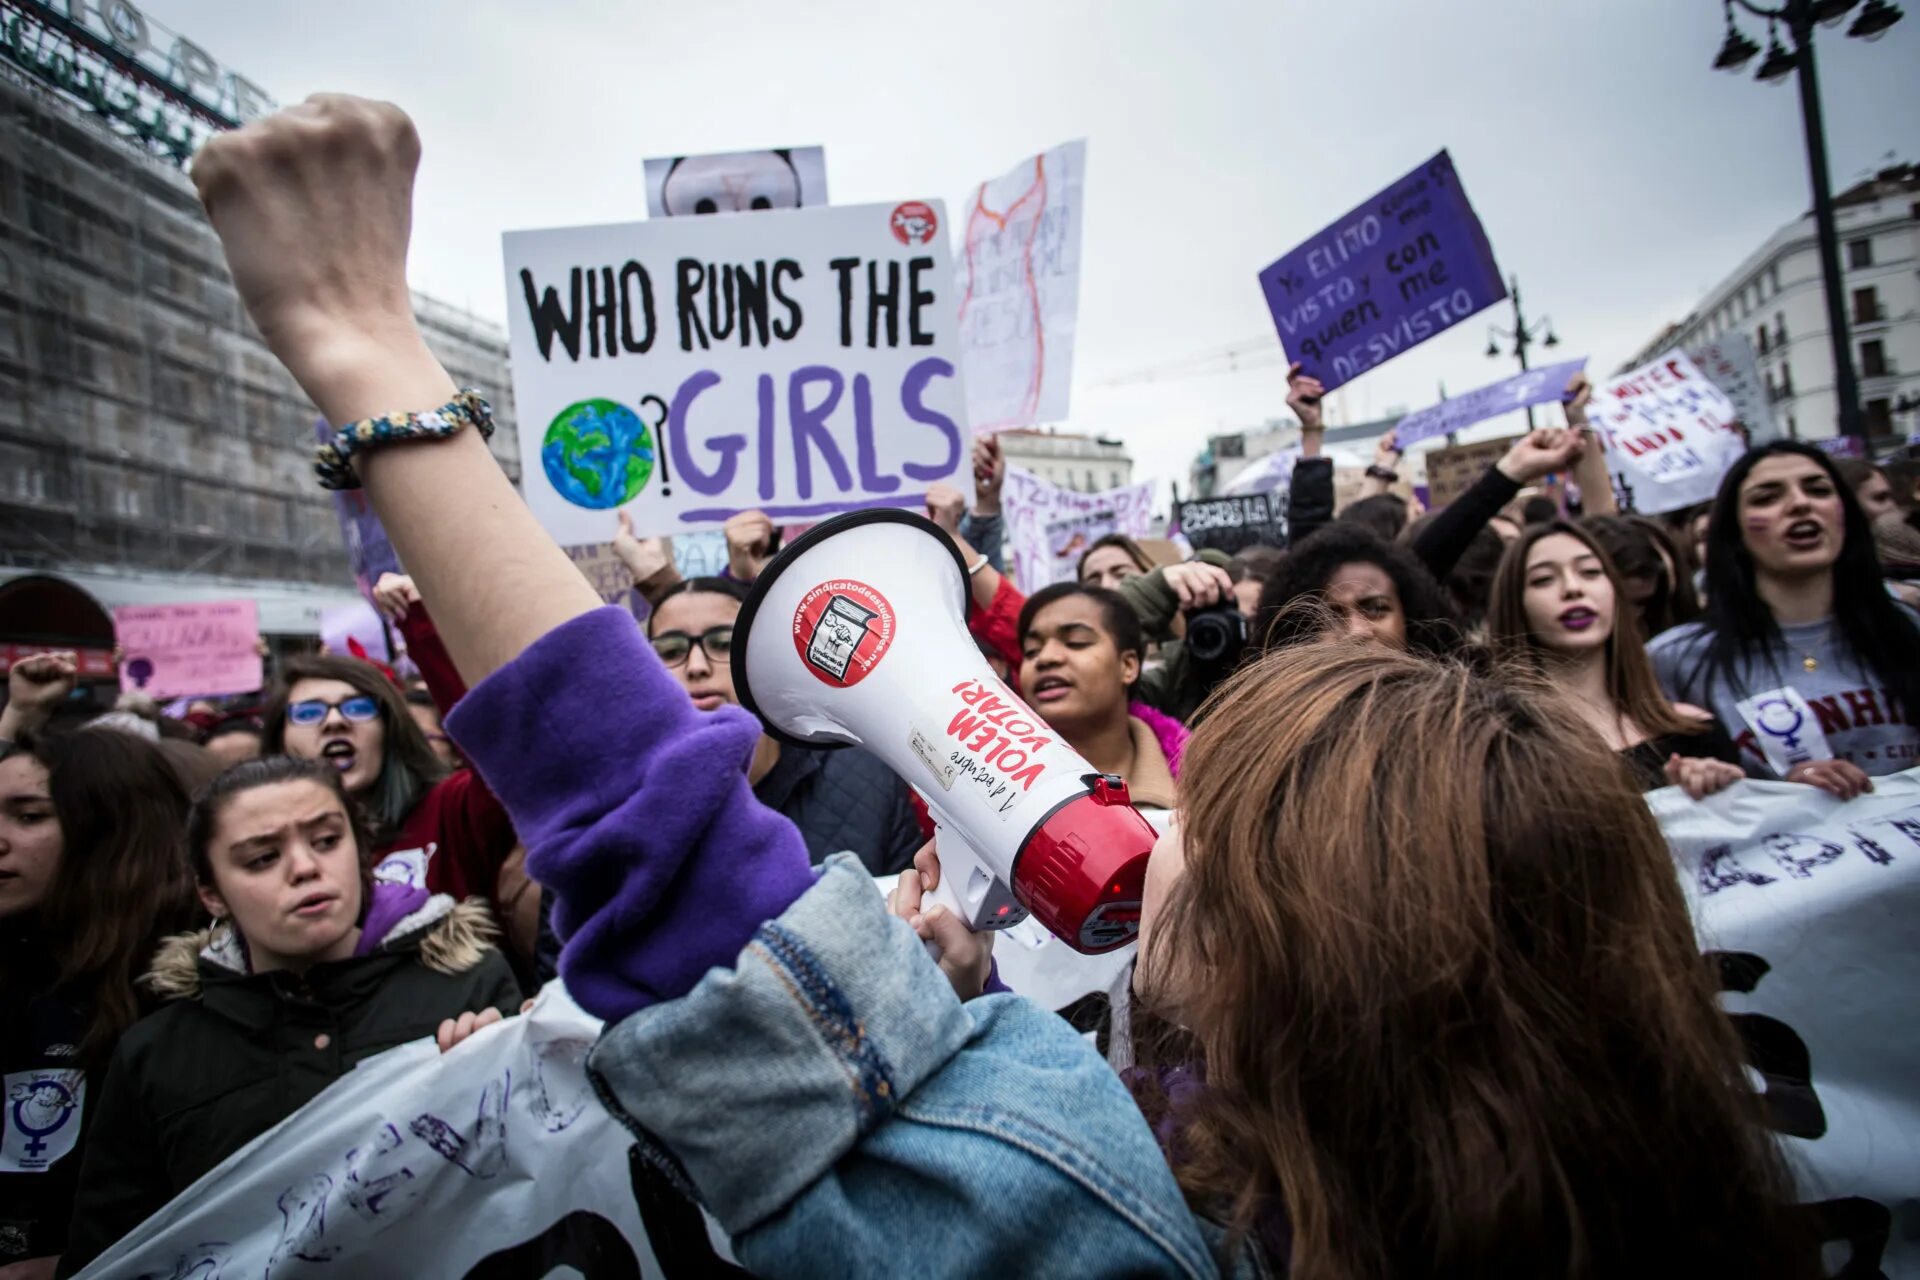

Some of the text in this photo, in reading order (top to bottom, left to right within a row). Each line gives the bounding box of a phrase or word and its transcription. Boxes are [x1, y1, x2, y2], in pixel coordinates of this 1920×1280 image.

[1279, 276, 1355, 336] VISTO
[1386, 230, 1441, 274] con
[1306, 214, 1381, 280] ELIJO
[519, 259, 658, 363] WHO
[676, 256, 805, 351] RUNS
[829, 256, 935, 348] THE
[1300, 259, 1448, 362] quien me
[1331, 288, 1474, 383] DESVISTO
[668, 357, 963, 501] GIRLS
[794, 581, 893, 672] www.sindicatodeestudiantes.net
[946, 708, 1046, 792] VOLEM
